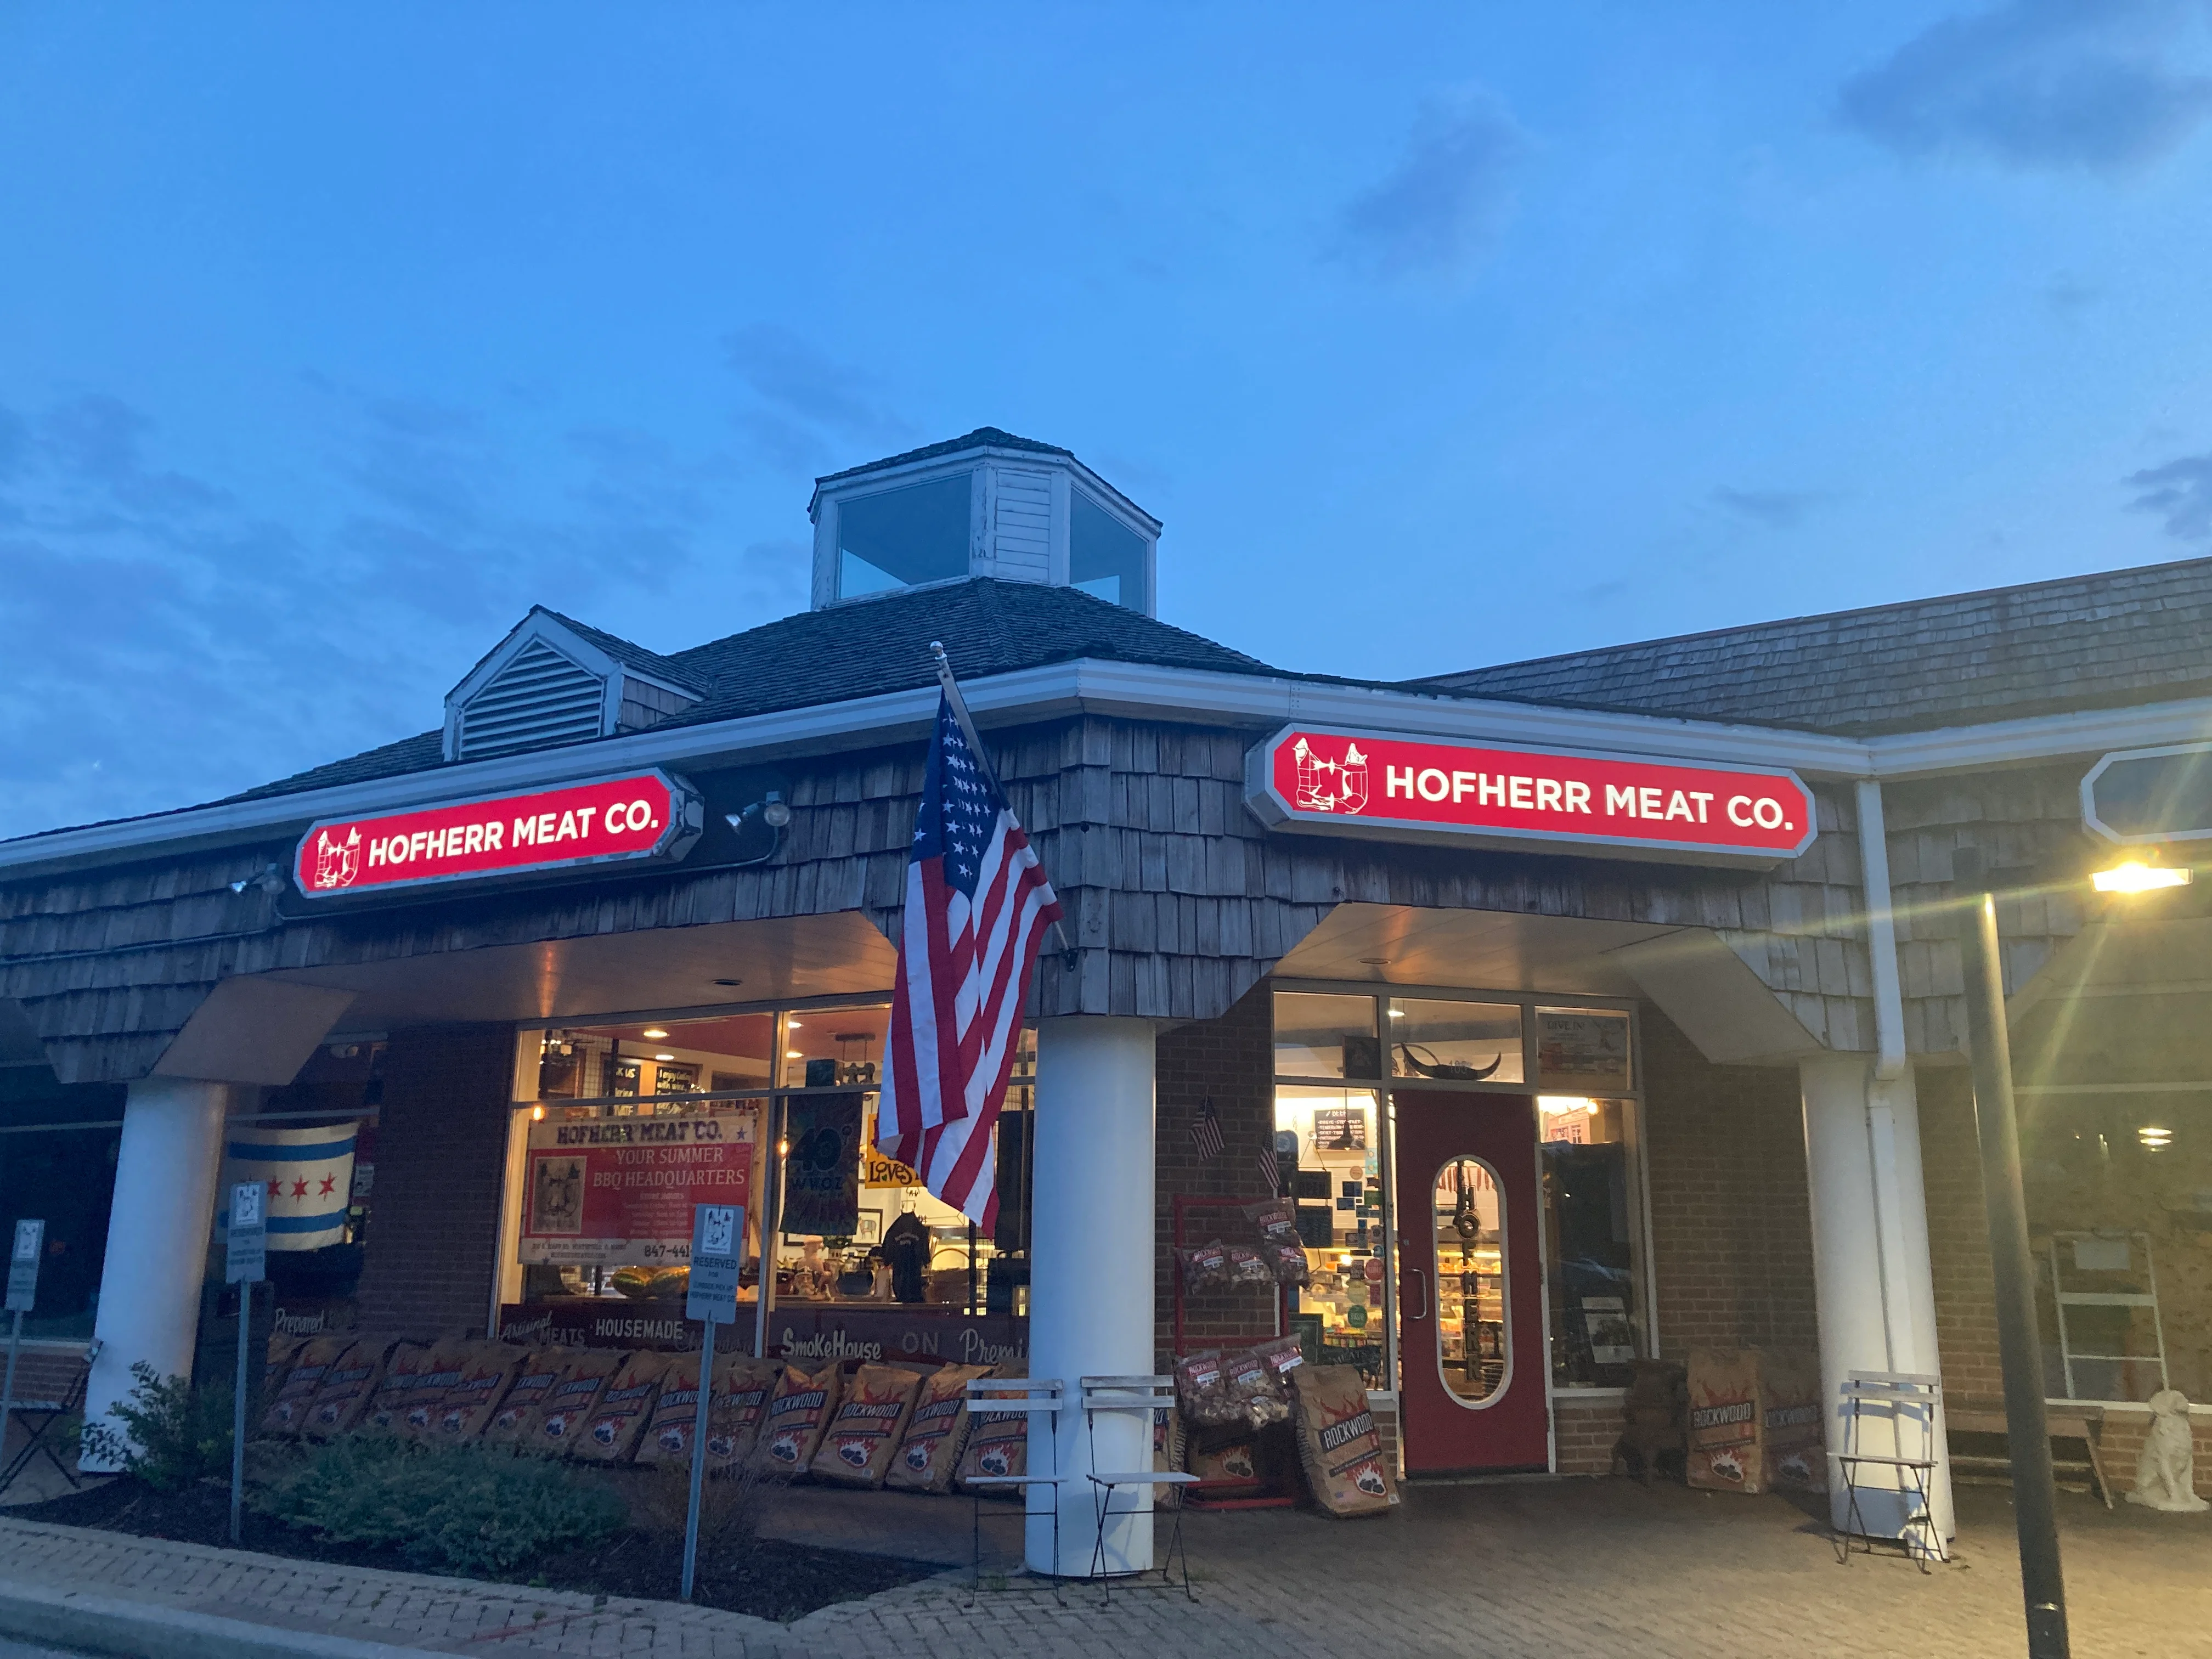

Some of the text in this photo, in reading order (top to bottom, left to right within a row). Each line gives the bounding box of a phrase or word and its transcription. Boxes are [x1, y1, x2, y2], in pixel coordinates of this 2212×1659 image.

[1387, 765, 1793, 830] HOFHERR MEAT CO.
[368, 799, 658, 867] HOFHERR MEAT CO.
[557, 1120, 723, 1144] HOFHERR MEAT CO.
[616, 1148, 724, 1165] YOUR SUMMER
[593, 1169, 744, 1190] BBQ HEADQUARTERS
[693, 1256, 737, 1269] RESERVED
[275, 1307, 325, 1338] Prepared
[596, 1318, 684, 1340] HOUSEMADE
[902, 1332, 939, 1356] ON
